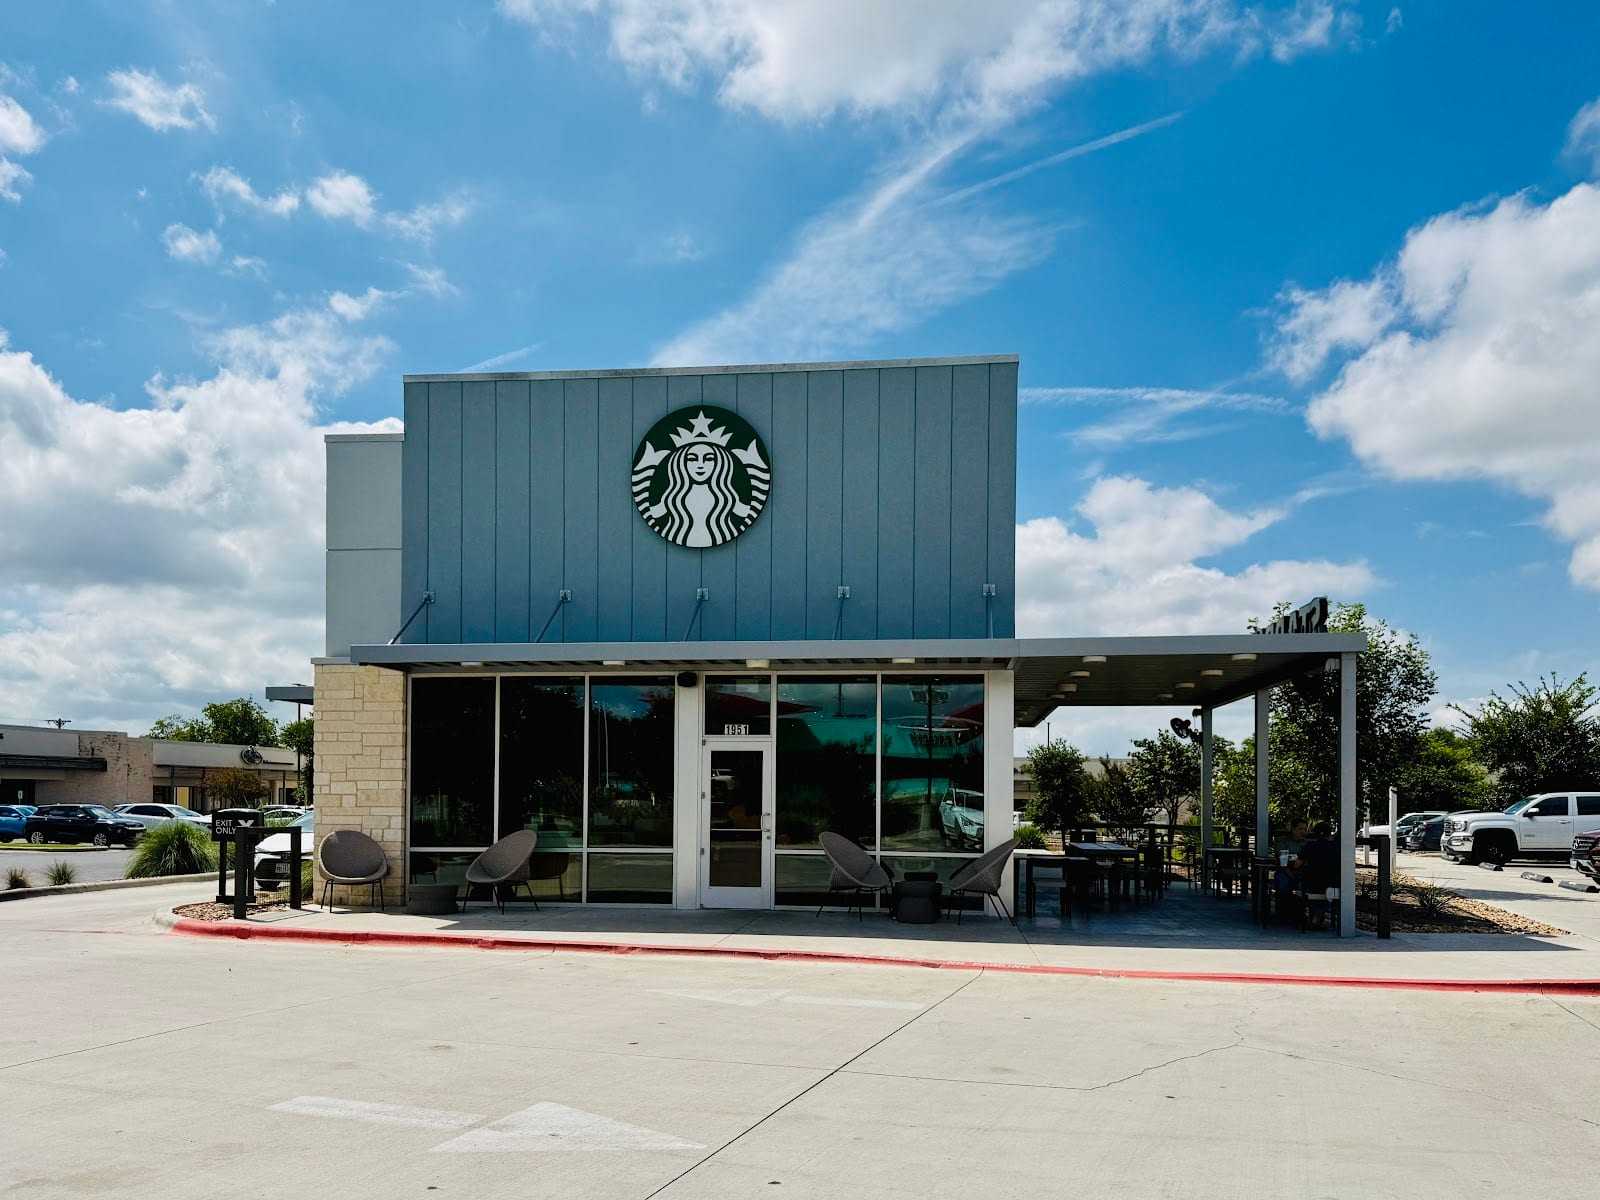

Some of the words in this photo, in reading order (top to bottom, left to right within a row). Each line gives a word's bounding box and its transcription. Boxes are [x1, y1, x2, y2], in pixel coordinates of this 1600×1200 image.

[725, 723, 748, 735] 1951
[216, 819, 233, 827] EXIT
[216, 827, 237, 835] ONLY
